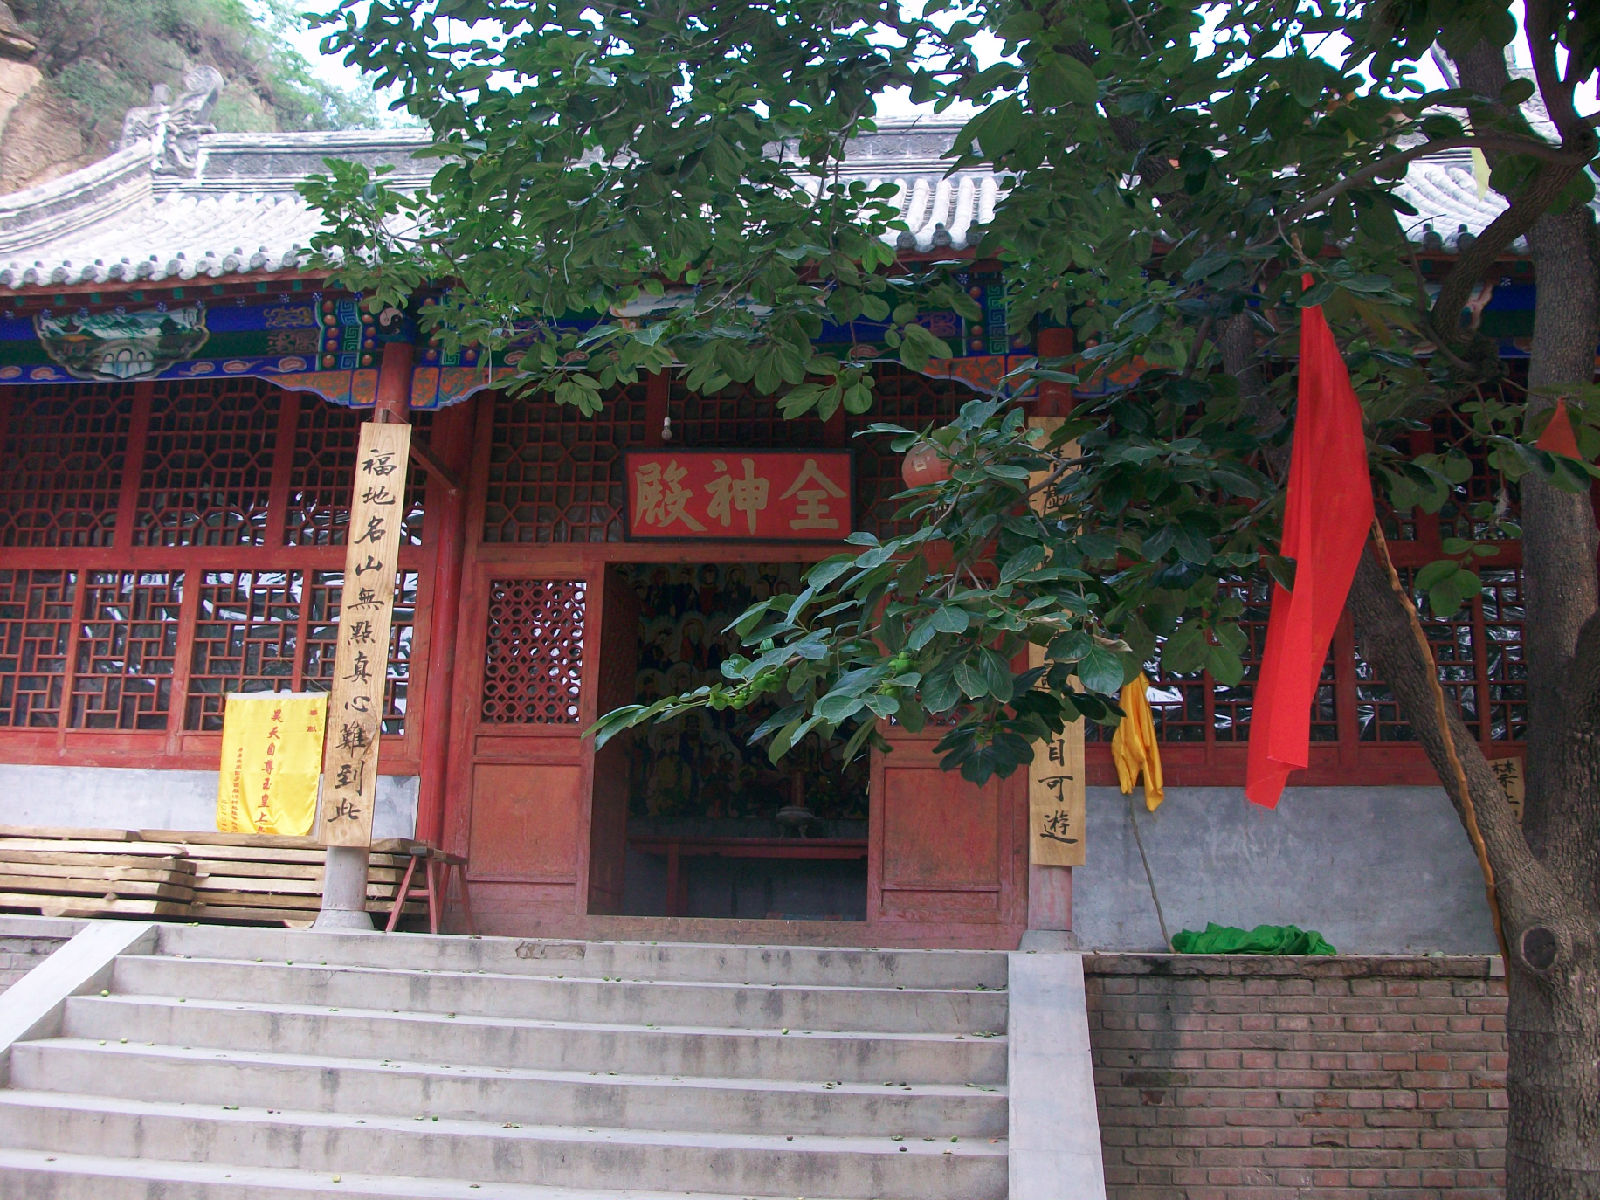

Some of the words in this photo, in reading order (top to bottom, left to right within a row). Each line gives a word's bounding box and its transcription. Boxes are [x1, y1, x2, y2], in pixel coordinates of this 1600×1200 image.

[633, 457, 848, 536] 全神殿
[327, 448, 398, 822] 福地名山無點真心難到此
